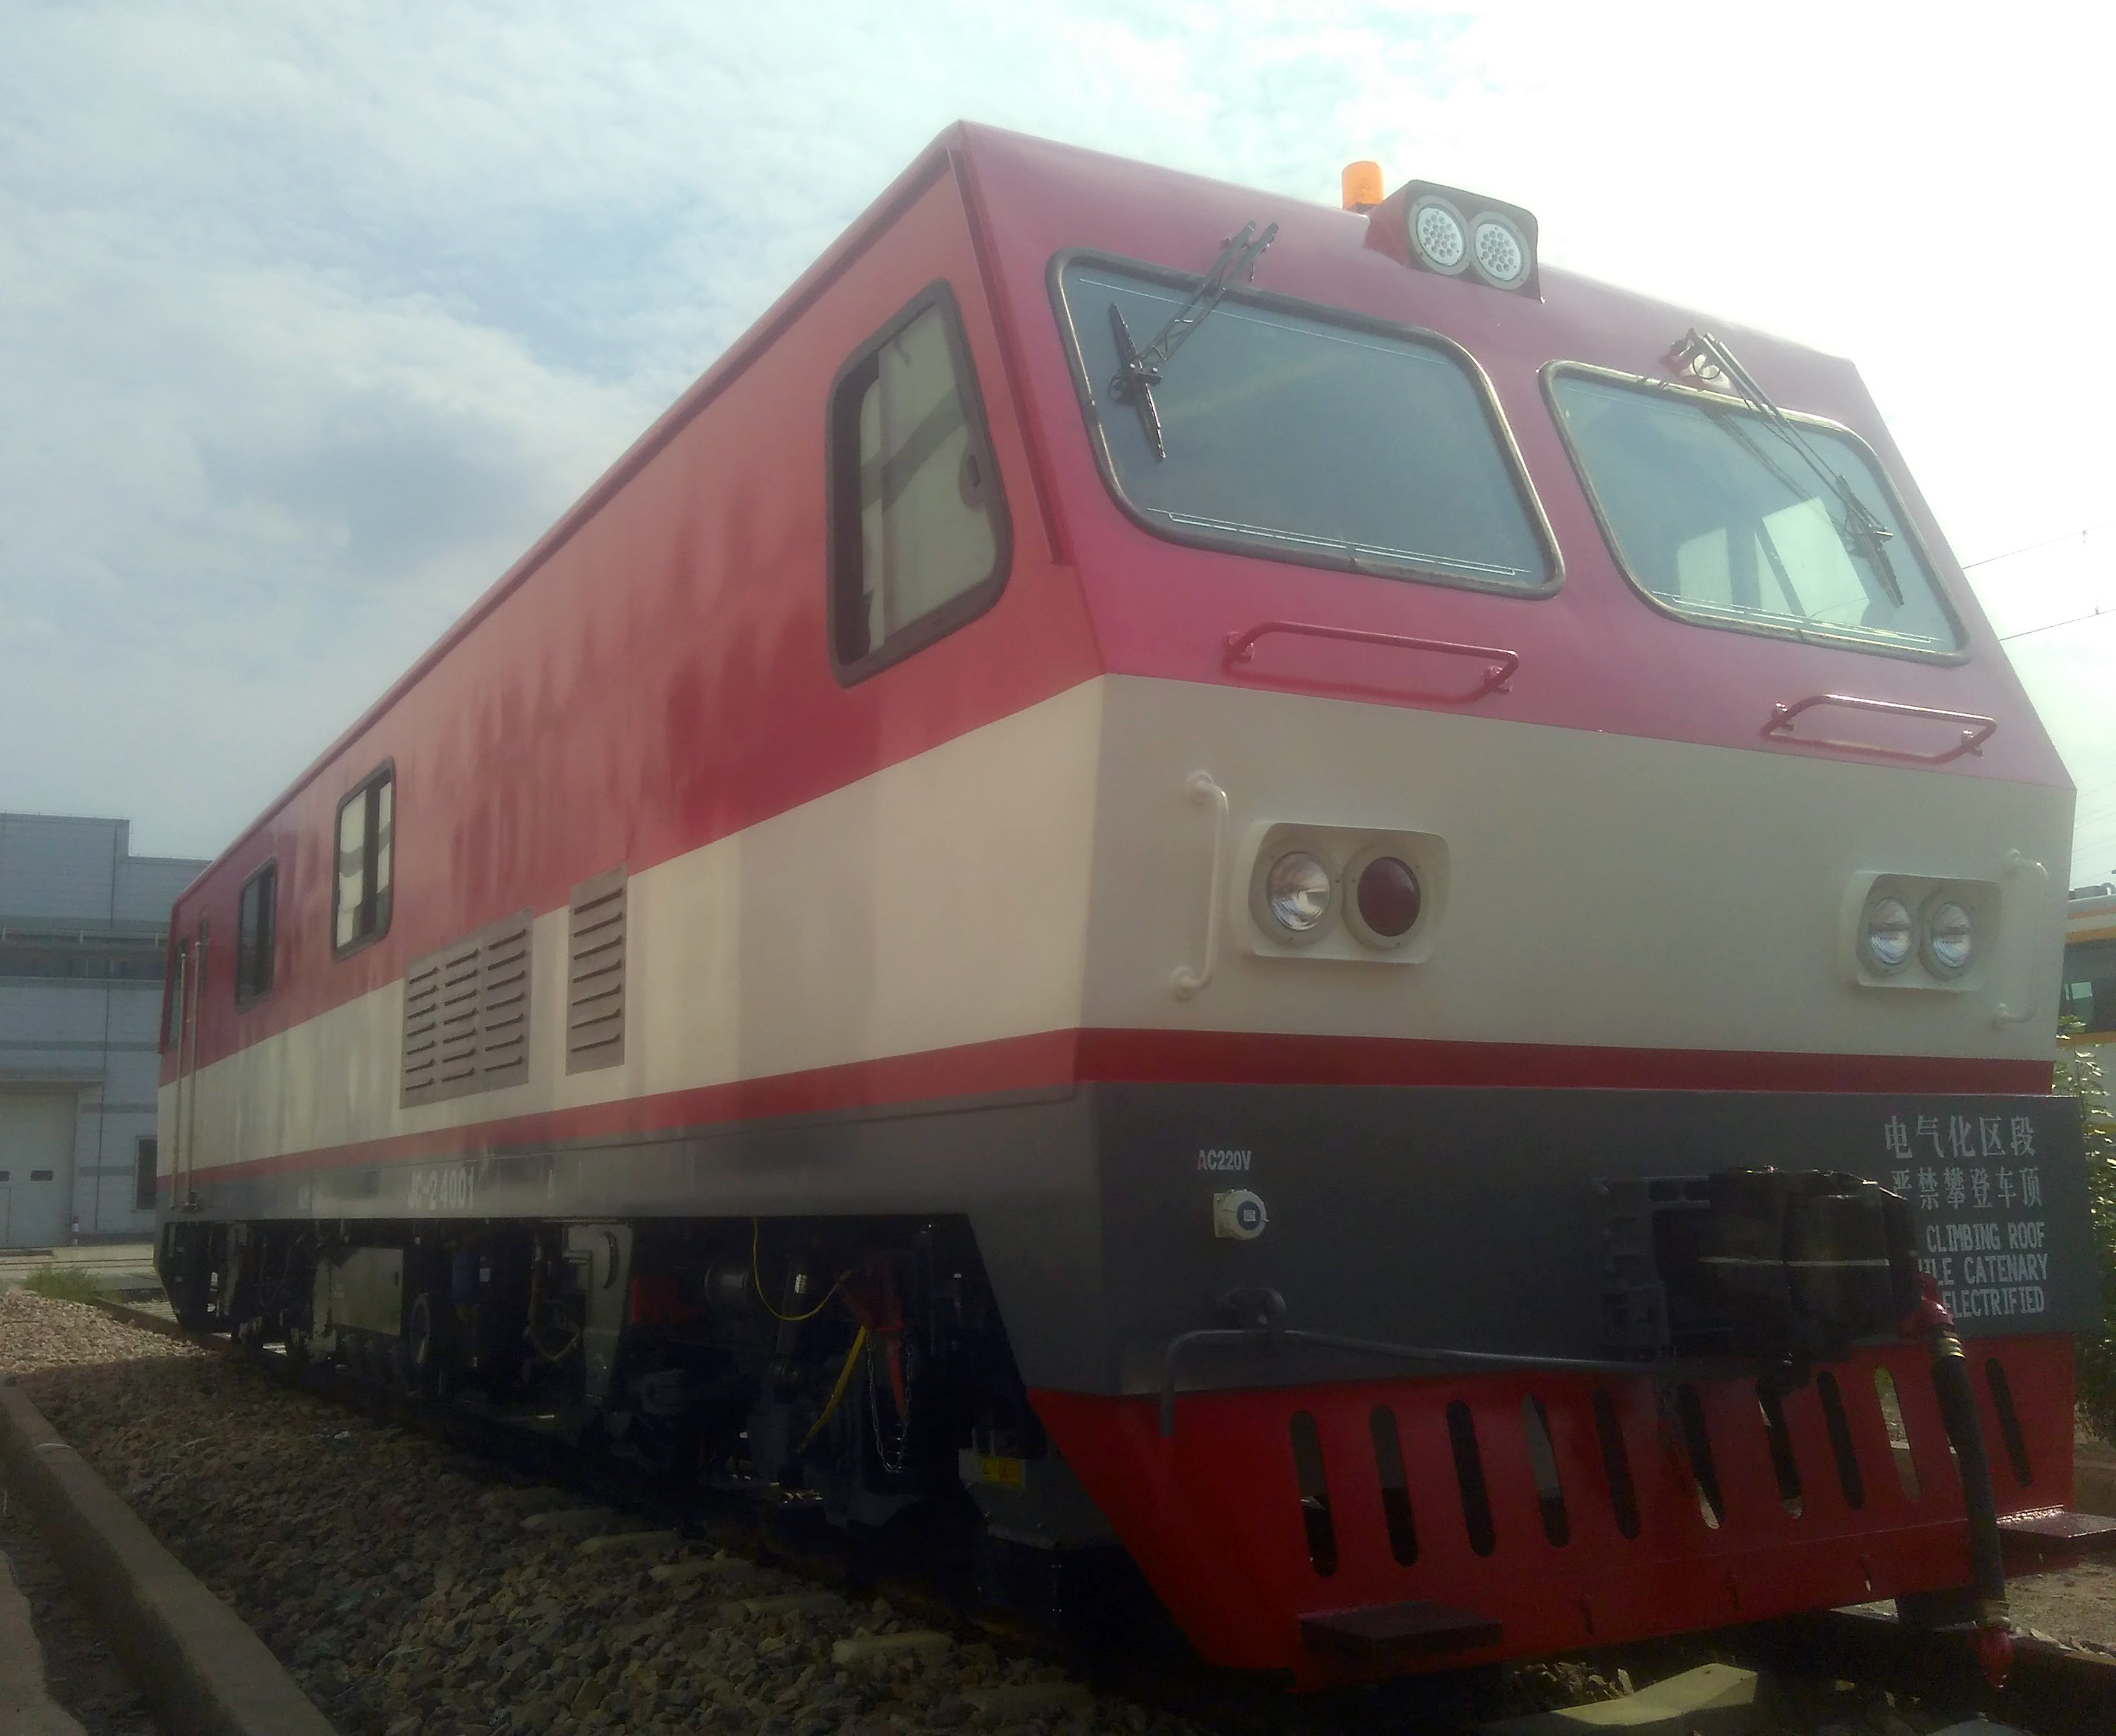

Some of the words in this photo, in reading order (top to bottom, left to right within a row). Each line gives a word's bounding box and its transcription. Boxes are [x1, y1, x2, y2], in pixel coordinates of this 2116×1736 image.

[1884, 1115, 2036, 1159] 电气化区段
[1197, 1149, 1251, 1171] AC220V
[1926, 1222, 2000, 1252] CLIMBING
[2008, 1221, 2045, 1250] ROOF
[1964, 1253, 2048, 1285] CATENARY
